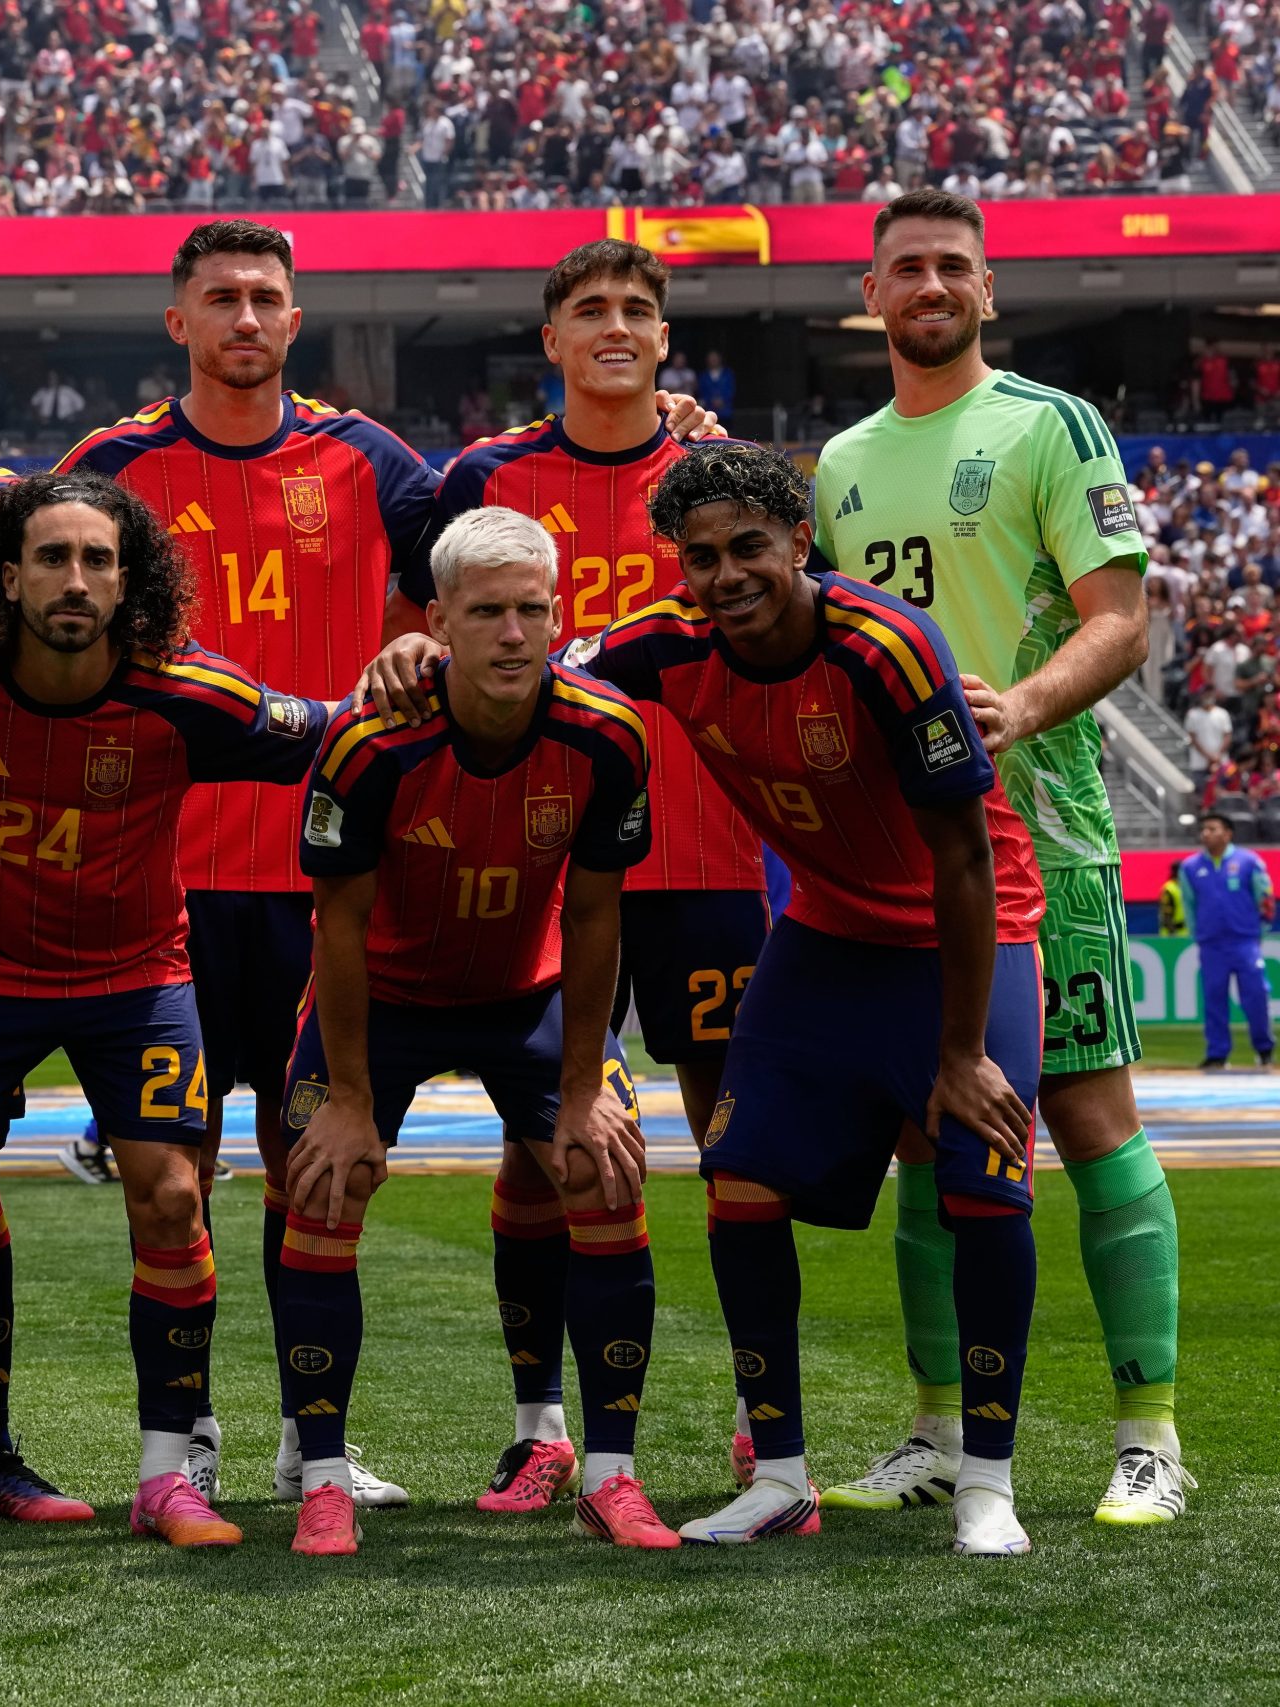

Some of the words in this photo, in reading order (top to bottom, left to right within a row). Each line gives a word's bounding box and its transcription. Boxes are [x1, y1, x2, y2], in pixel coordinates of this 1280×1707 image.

[222, 550, 290, 624] 14
[572, 554, 655, 628] 22
[865, 535, 935, 609] 23
[927, 741, 962, 763] EDUCATION
[940, 755, 954, 765] FIFA
[751, 776, 823, 832] 19
[457, 867, 518, 918] 10
[1043, 972, 1108, 1052] 23
[140, 1046, 208, 1121] 24
